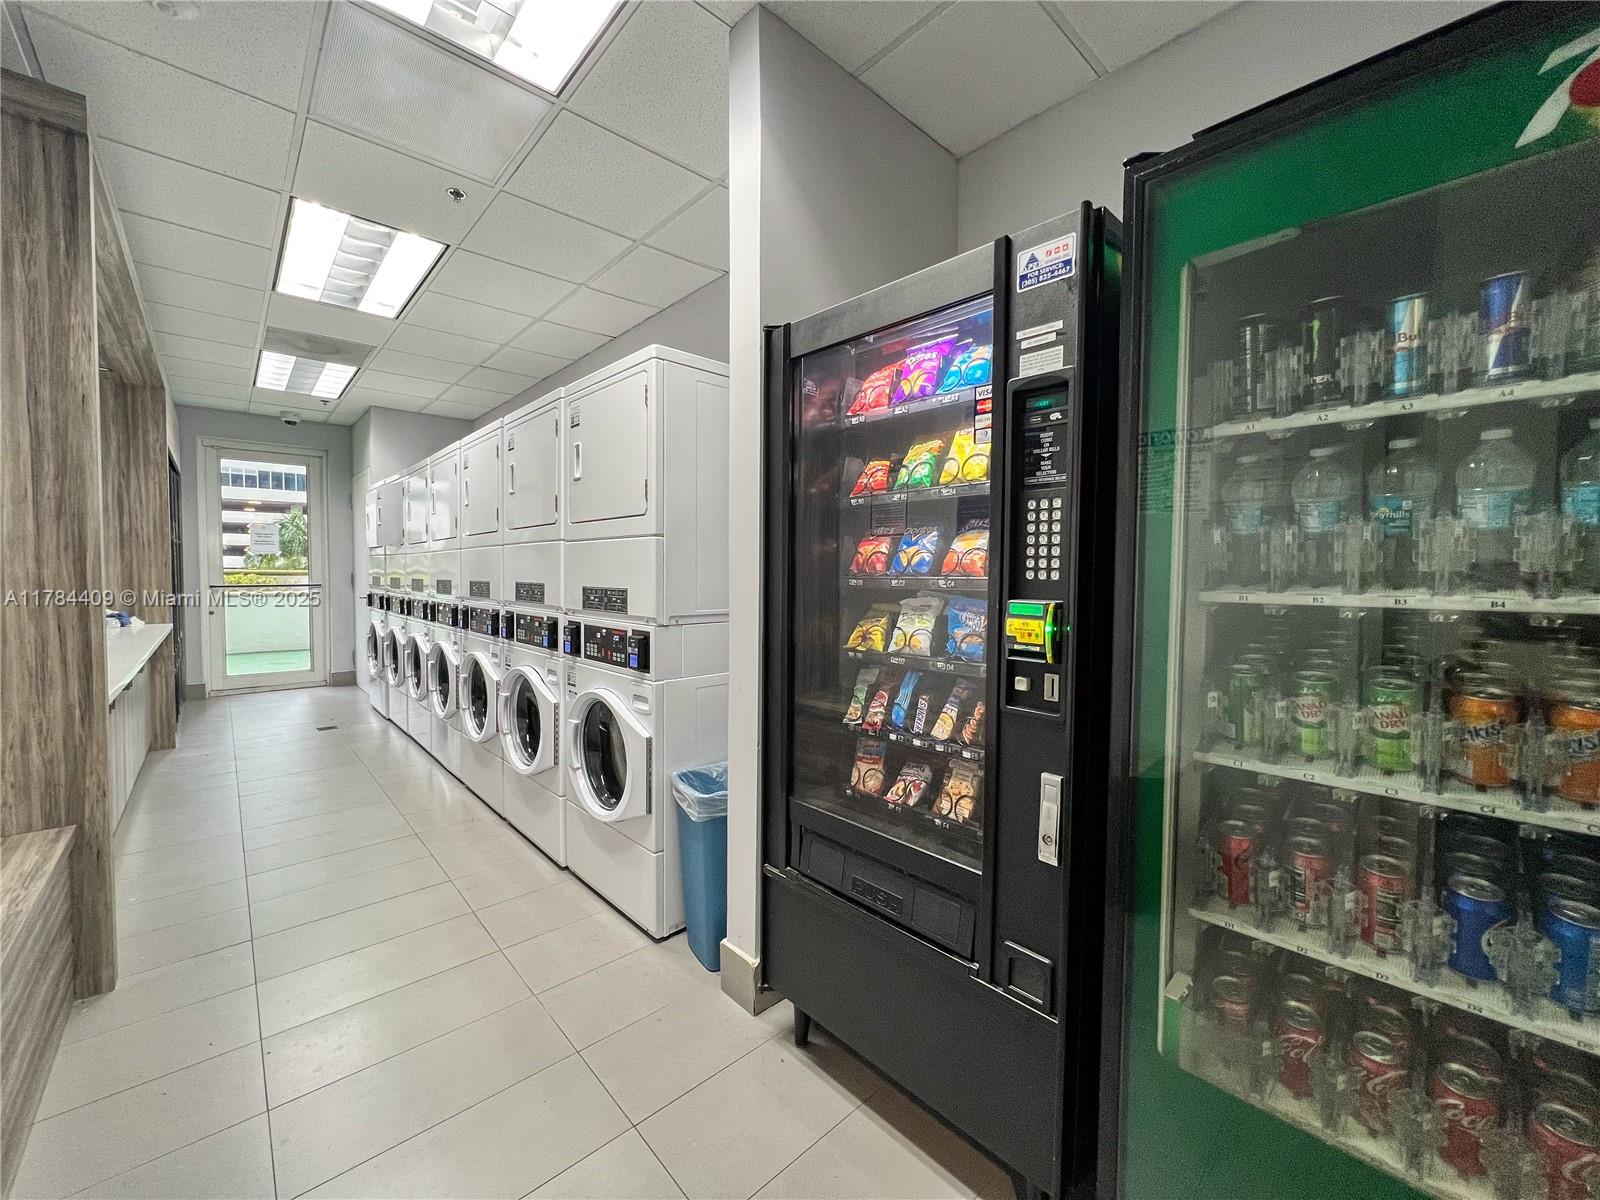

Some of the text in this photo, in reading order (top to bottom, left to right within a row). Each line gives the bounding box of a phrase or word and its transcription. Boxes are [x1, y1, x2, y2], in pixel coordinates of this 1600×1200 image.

[1022, 277, 1038, 288] (305)
[1039, 266, 1070, 282] 825-4467
[1028, 270, 1038, 279] FOR
[1380, 720, 1406, 729] DRY
